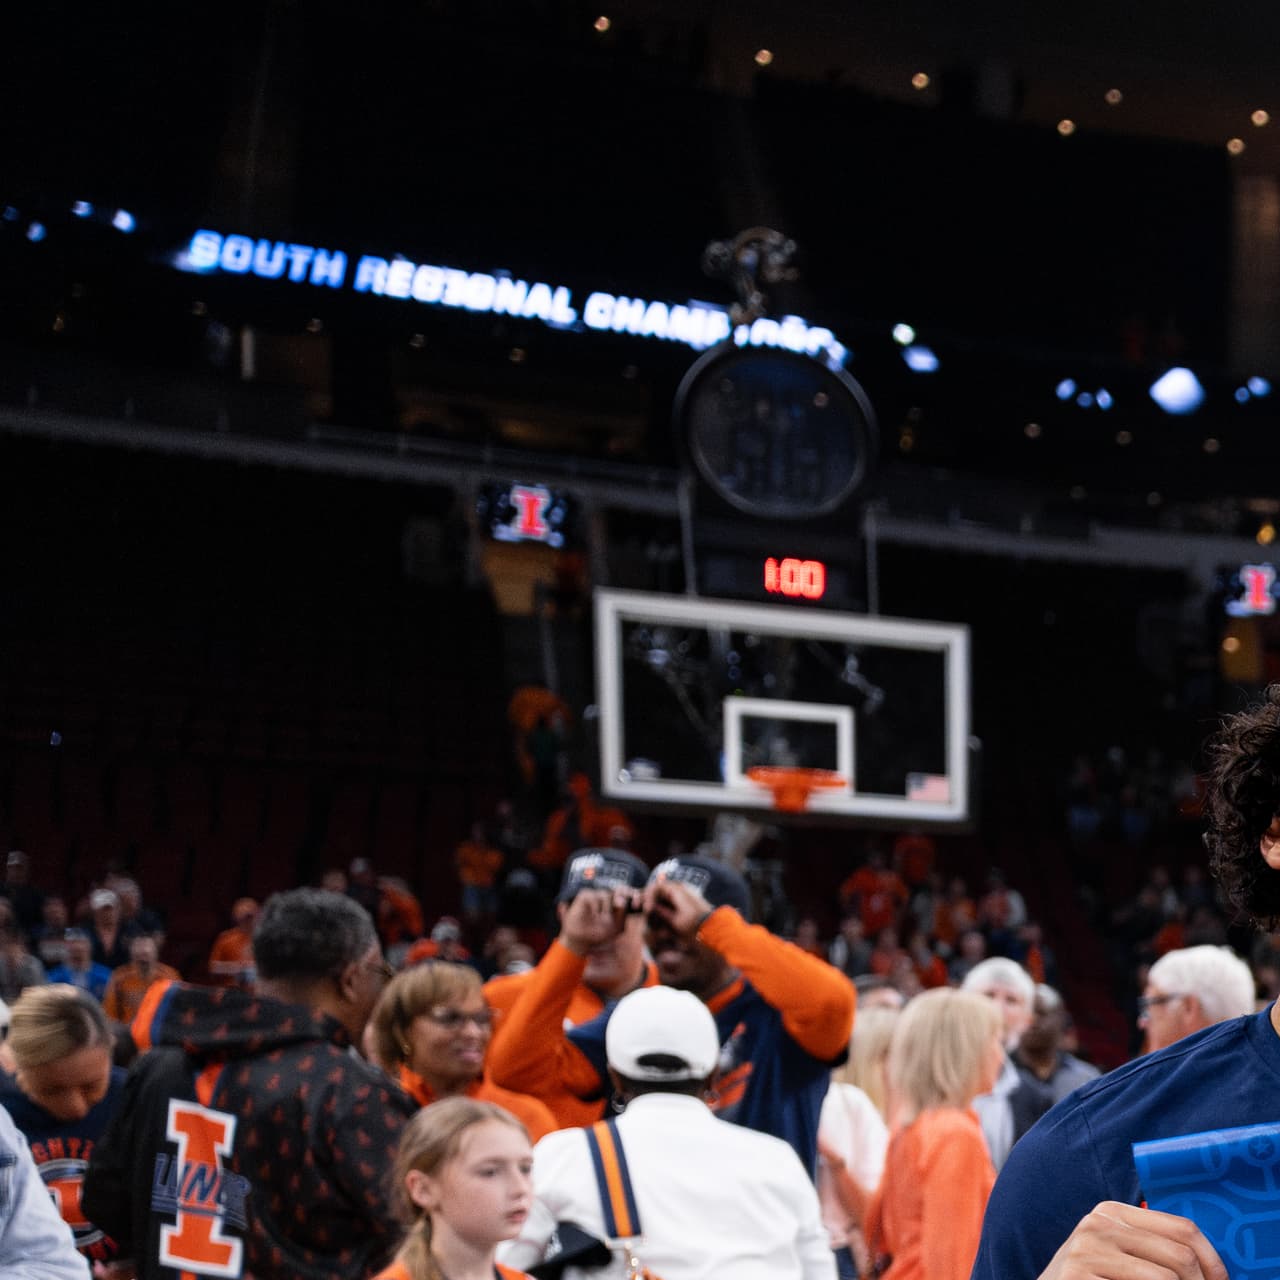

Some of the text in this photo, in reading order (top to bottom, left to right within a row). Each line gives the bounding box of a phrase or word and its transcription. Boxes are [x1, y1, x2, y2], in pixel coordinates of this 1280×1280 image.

[188, 229, 348, 289] SOUTH
[353, 254, 577, 325] REGIONAL
[765, 556, 827, 600] 1:00
